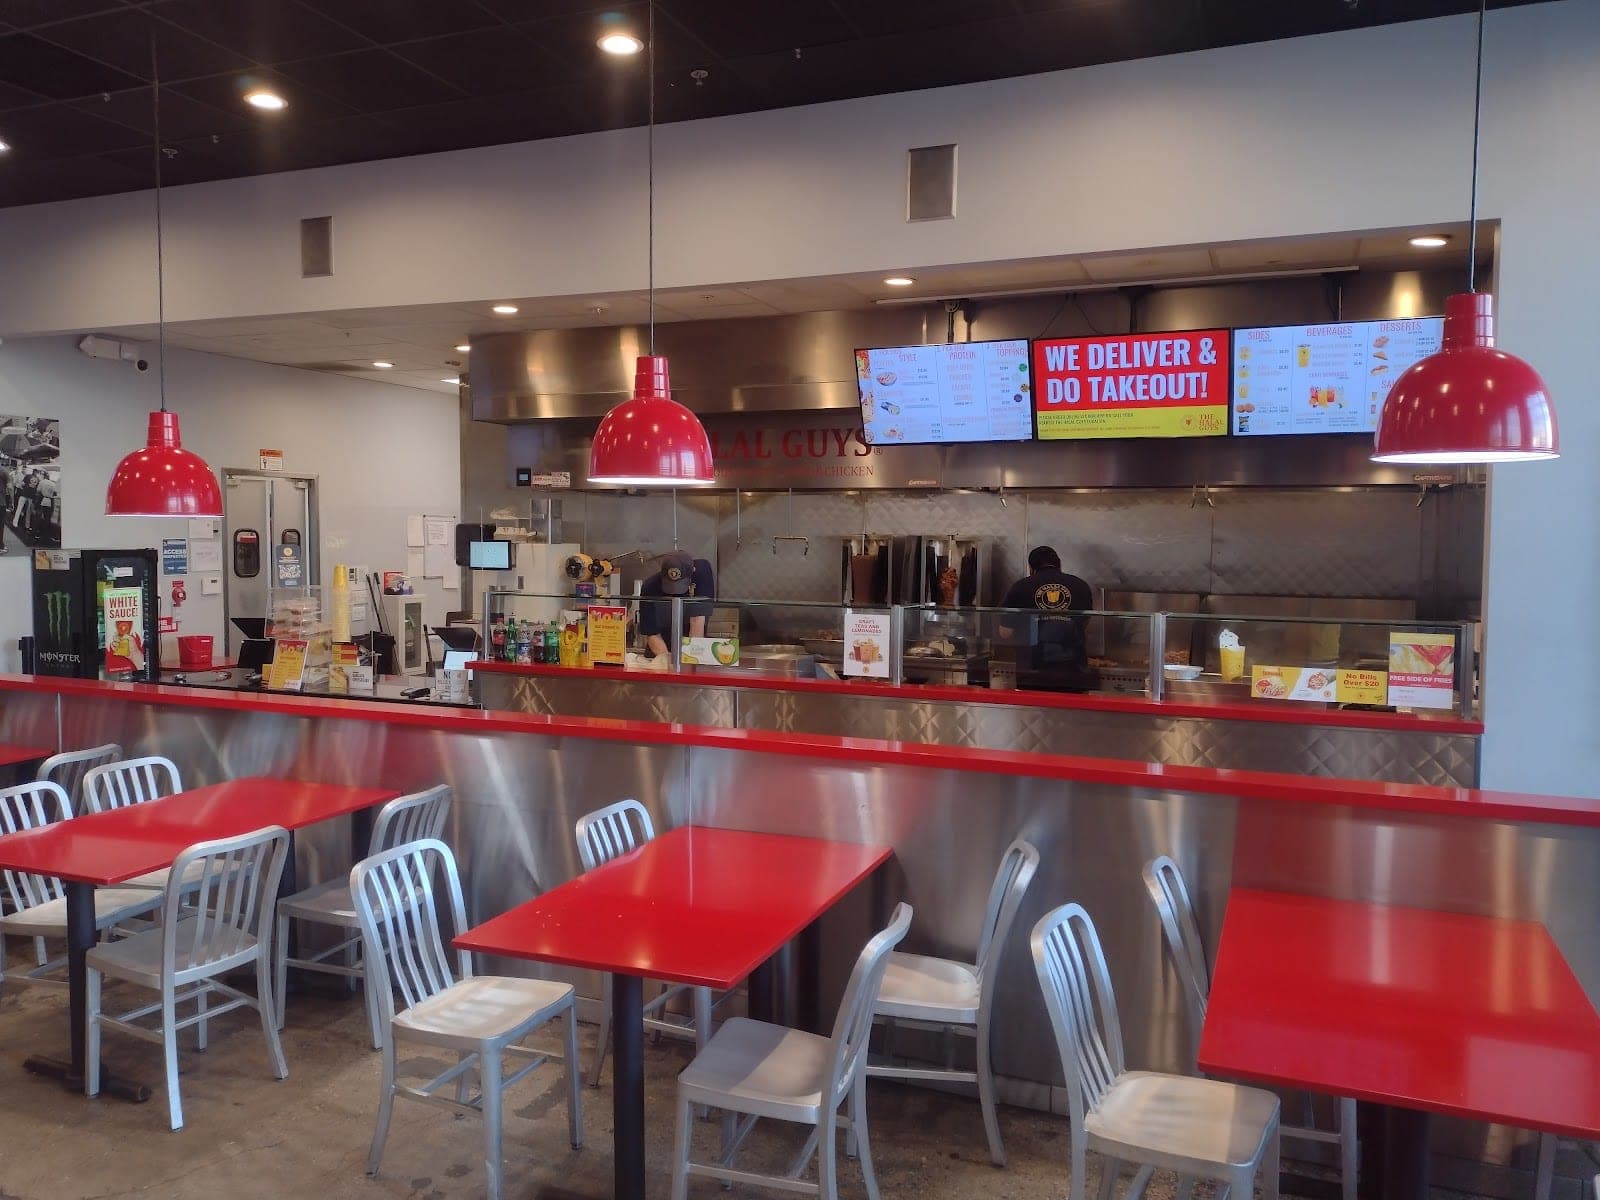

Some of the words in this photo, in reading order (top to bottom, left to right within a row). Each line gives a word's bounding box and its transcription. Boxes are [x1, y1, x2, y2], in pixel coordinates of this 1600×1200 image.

[1306, 326, 1353, 337] BEVERAGES
[1380, 321, 1422, 332] DESSERTS
[1247, 331, 1270, 340] SIDES
[1045, 345, 1081, 371] WE
[1088, 339, 1191, 369] DELIVER
[1199, 337, 1217, 365] &
[1047, 378, 1081, 404] DO
[1088, 372, 1208, 402] TAKEOUT!
[109, 596, 138, 608] WHITE
[109, 608, 138, 619] SAUCE!
[40, 652, 80, 663] MONSTER
[1359, 673, 1377, 681] Bills
